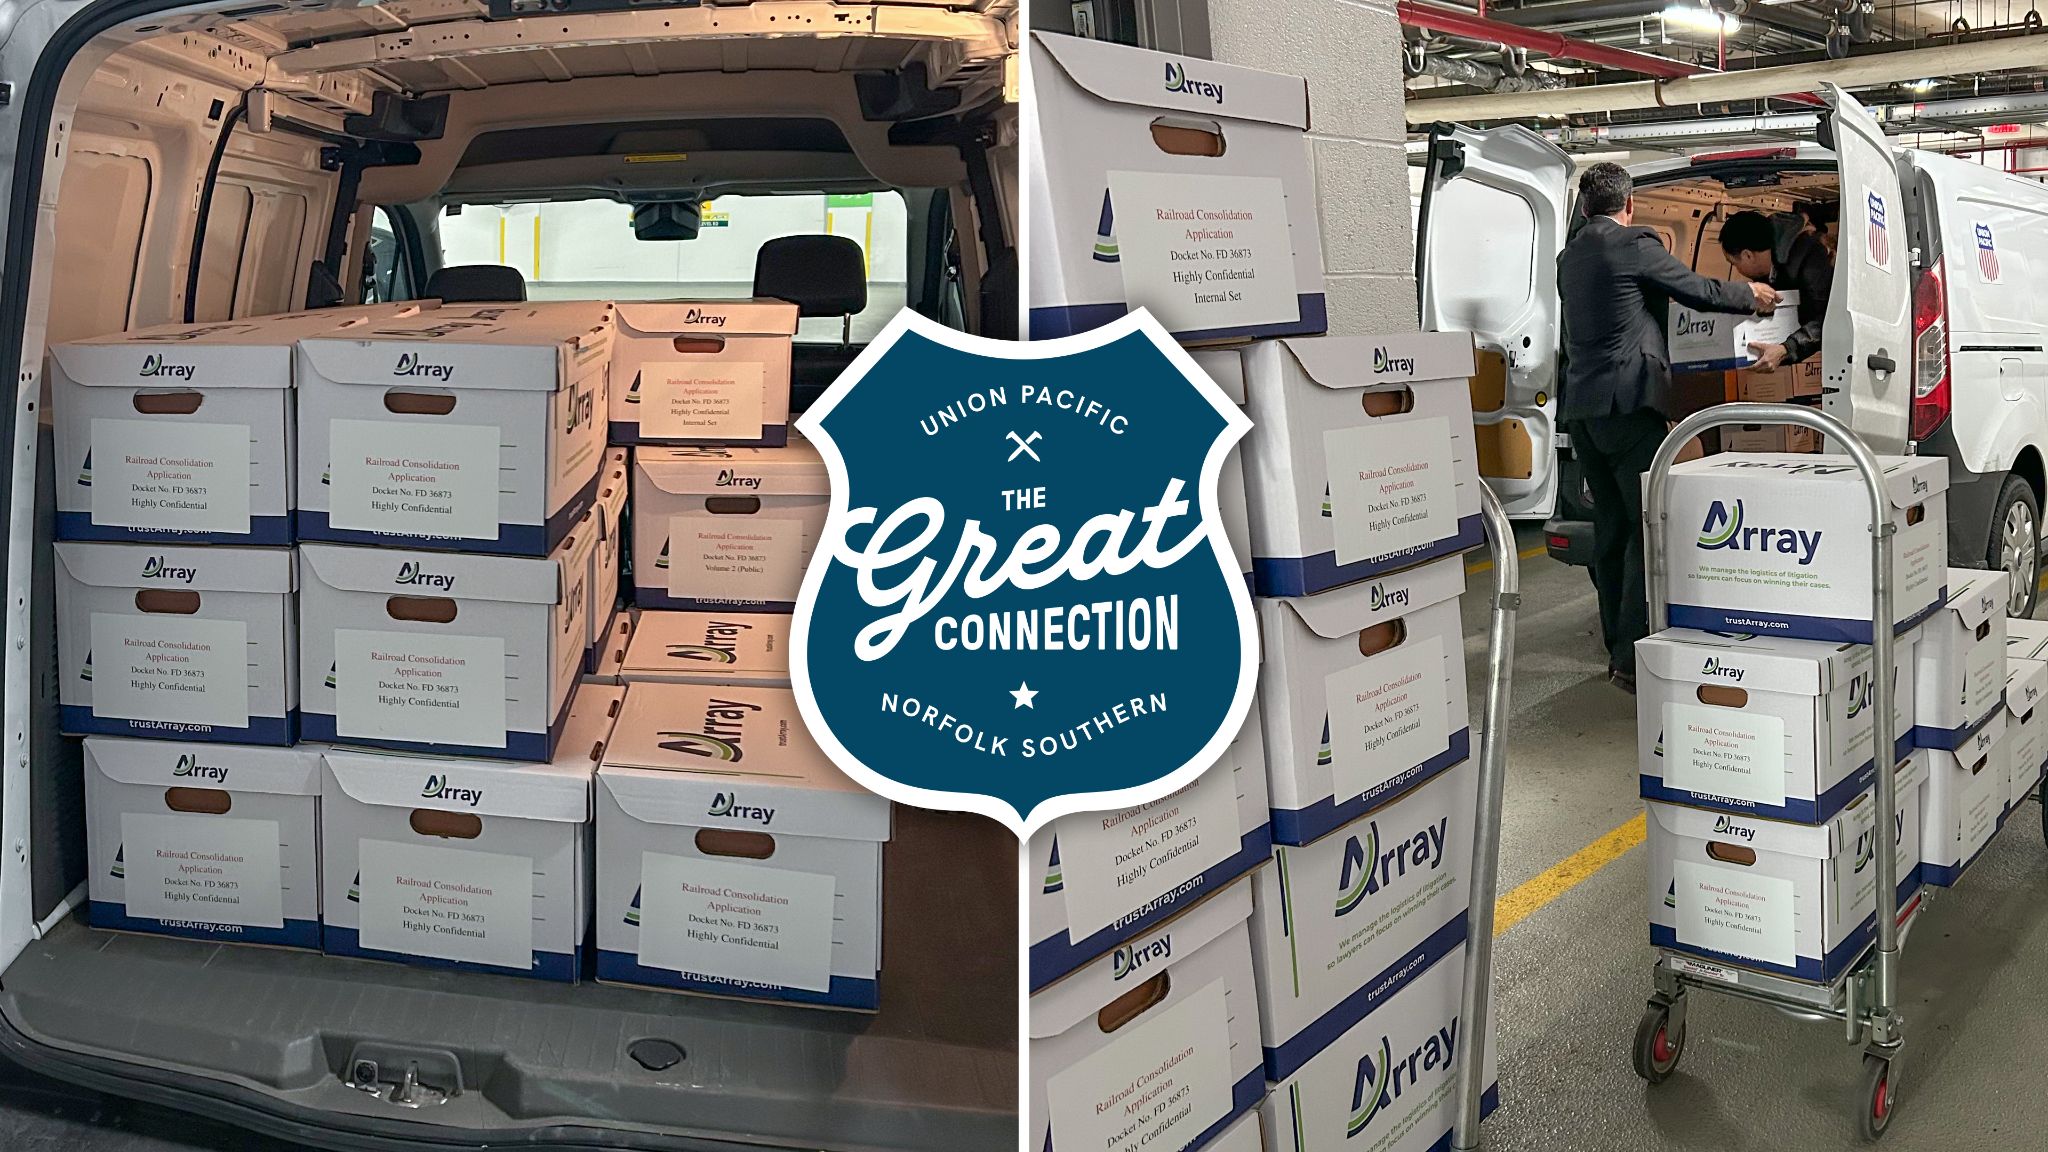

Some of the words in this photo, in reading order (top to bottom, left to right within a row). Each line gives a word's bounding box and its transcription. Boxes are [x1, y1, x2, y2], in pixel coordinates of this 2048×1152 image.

[1166, 62, 1222, 104] Array
[1156, 208, 1195, 220] Railroad
[1196, 209, 1253, 221] Consolidation
[1185, 228, 1234, 242] Application
[1170, 250, 1199, 261] Docket
[1200, 249, 1214, 260] No.
[1215, 249, 1228, 259] FD
[1229, 248, 1252, 259] 36873
[1172, 270, 1202, 285] Highly
[1204, 267, 1255, 281] Confidential
[1194, 291, 1226, 304] Internal
[1228, 290, 1242, 301] Set
[684, 309, 726, 327] Array
[1677, 310, 1715, 336] Array
[140, 354, 195, 380] Array
[394, 353, 453, 381] Array
[1374, 346, 1414, 376] Array
[365, 456, 400, 467] Railroad
[401, 459, 460, 471] Consolidation
[387, 472, 436, 483] Application
[715, 469, 761, 489] Array
[372, 486, 398, 495] Docket
[399, 488, 413, 496] No.
[414, 489, 428, 497] FD
[428, 489, 452, 499] 36873
[371, 500, 399, 513] Highly
[400, 502, 452, 514] Confidential
[1697, 499, 1822, 565] Array
[142, 556, 196, 583] Array
[396, 562, 454, 590] Array
[1697, 574, 1720, 582] lawyers
[1763, 579, 1790, 587] winning
[1371, 582, 1408, 611] Array
[1725, 616, 1789, 629] trustArray.com
[124, 637, 156, 648] Railroad
[157, 640, 211, 651] Consolidation
[666, 621, 752, 664] Array
[145, 652, 190, 663] Application
[371, 651, 406, 662] Railroad
[407, 654, 466, 666] Consolidation
[1702, 657, 1744, 681] Array
[130, 666, 155, 675] Docket
[156, 667, 169, 675] No.
[170, 668, 182, 676] FD
[183, 669, 205, 678] 36873
[394, 667, 442, 678] Application
[130, 679, 156, 691] Highly
[158, 681, 206, 693] Confidential
[378, 680, 405, 690] Docket
[406, 682, 419, 691] No.
[421, 683, 434, 692] FD
[436, 684, 459, 694] 36873
[378, 694, 406, 707] Highly
[407, 697, 460, 709] Confidential
[128, 719, 212, 733] trustArray.com
[657, 699, 761, 762] Array
[173, 754, 228, 783] Array
[421, 775, 482, 806] Array
[1361, 764, 1423, 801] trustArray.com
[708, 792, 774, 824] Array
[1690, 791, 1755, 808] trustArray.com
[1102, 805, 1140, 830] Railroad
[1131, 807, 1180, 837] Application
[1713, 816, 1756, 841] Array
[1115, 846, 1144, 866] Docket
[1146, 839, 1159, 850] No.
[1161, 830, 1173, 842] FD
[1175, 817, 1197, 835] 36873
[1116, 865, 1147, 887] Highly
[1150, 835, 1199, 869] Confidential
[1335, 816, 1447, 917] Array
[396, 875, 432, 888] Railroad
[433, 880, 492, 896] Consolidation
[681, 882, 721, 896] Railroad
[723, 888, 789, 905] Consolidation
[419, 892, 469, 907] Application
[706, 901, 761, 916] Application
[1113, 875, 1204, 930] trustArray.com
[1339, 940, 1350, 949] We
[1352, 920, 1377, 943] manage
[1380, 913, 1390, 923] the
[1391, 893, 1415, 914] logistics
[1416, 887, 1421, 897] of
[1423, 873, 1447, 894] litigation
[403, 905, 430, 917] Docket
[431, 909, 445, 918] No.
[447, 911, 460, 920] FD
[460, 913, 485, 923] 36873
[688, 913, 718, 926] Docket
[720, 918, 734, 927] No.
[737, 920, 751, 930] FD
[752, 922, 779, 933] 36873
[402, 920, 431, 933] Highly
[432, 924, 486, 938] Confidential
[687, 928, 717, 943] Highly
[720, 933, 779, 950] Confidential
[1114, 934, 1170, 981] Array
[1368, 954, 1424, 1001] trustArray.com
[1096, 1082, 1135, 1115] Railroad
[1137, 1046, 1194, 1088] Consolidation
[1346, 1017, 1458, 1139] Array
[1124, 1078, 1173, 1117] Application
[1107, 1124, 1136, 1148] Docket
[1138, 1115, 1152, 1128] No.
[1154, 1102, 1166, 1116] FD
[1168, 1085, 1190, 1107] 36873
[1141, 1102, 1192, 1145] Confidential
